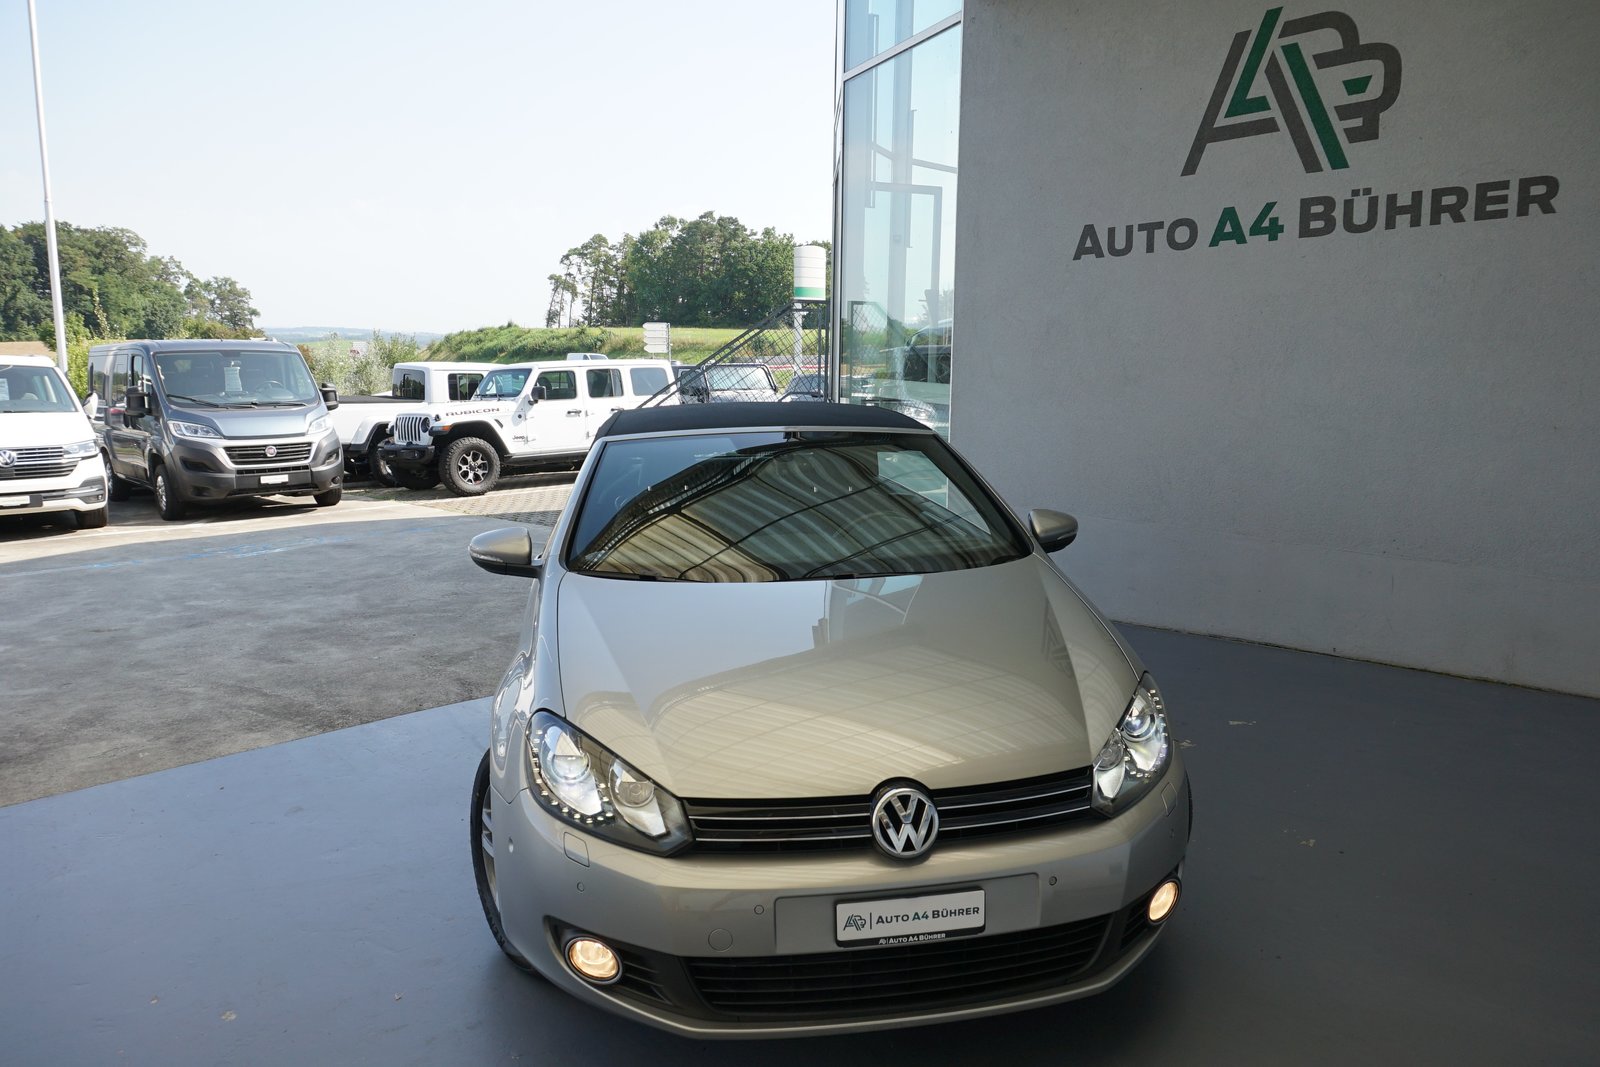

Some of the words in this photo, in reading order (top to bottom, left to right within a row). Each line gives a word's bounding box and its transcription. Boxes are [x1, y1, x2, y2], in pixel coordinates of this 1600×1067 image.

[1072, 217, 1199, 261] AUTO
[1208, 201, 1285, 248] A4
[1298, 175, 1560, 239] BÜHRER
[445, 407, 500, 417] RUBICON
[873, 788, 939, 858] VW
[876, 914, 910, 925] AUTO
[912, 911, 929, 922] A4
[932, 906, 980, 919] BÜHRER
[908, 934, 918, 942] A4
[919, 933, 946, 941] BÜHRER
